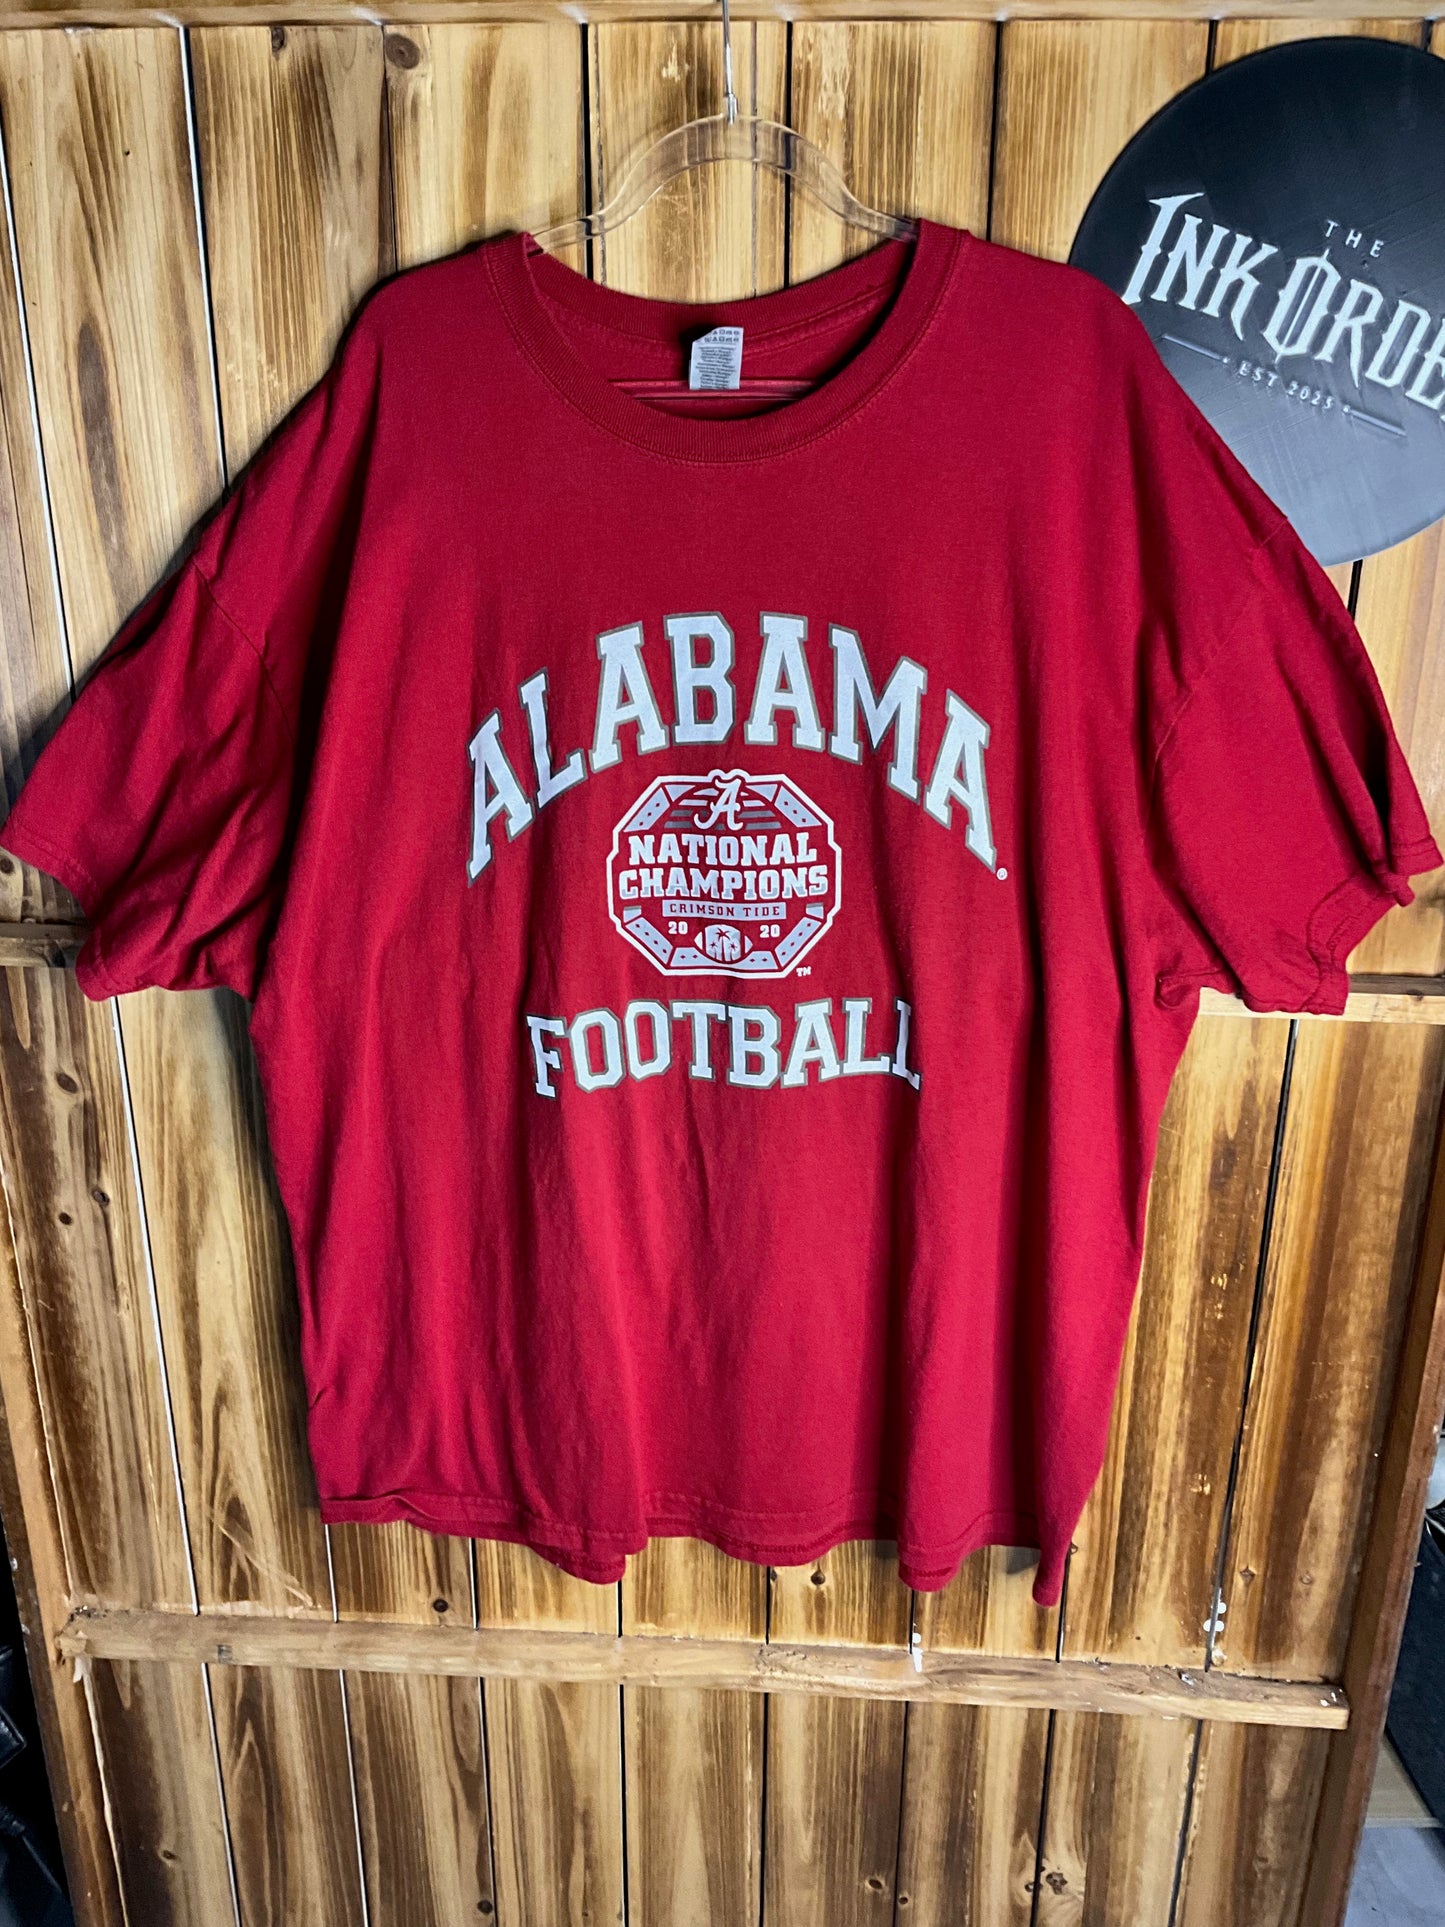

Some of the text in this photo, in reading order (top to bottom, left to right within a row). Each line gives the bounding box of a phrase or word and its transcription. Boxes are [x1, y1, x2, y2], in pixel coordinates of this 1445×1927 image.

[1323, 219, 1385, 258] THE
[1121, 192, 1445, 422] INK ORDE
[1240, 360, 1334, 409] EST 2025
[467, 611, 997, 888] ALABAMA
[628, 832, 817, 867] NATIONAL
[618, 864, 828, 900] CHAMPIONS
[668, 921, 780, 938] 20 20
[669, 903, 780, 917] CRIMSON TIDE
[526, 997, 922, 1099] FOOTBALL
